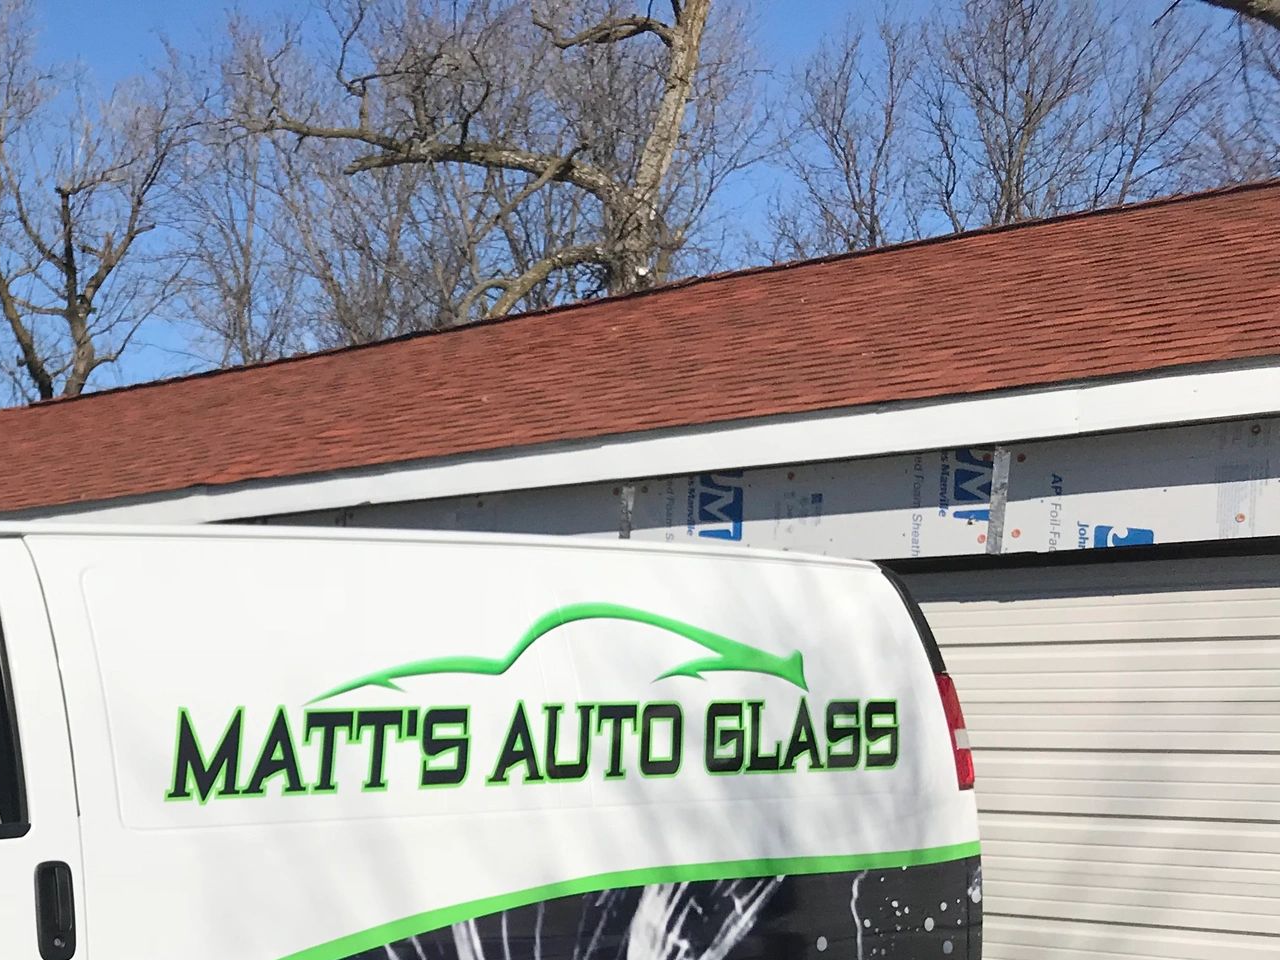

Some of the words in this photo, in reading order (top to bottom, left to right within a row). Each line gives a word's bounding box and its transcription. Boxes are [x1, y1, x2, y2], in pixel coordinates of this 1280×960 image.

[164, 703, 472, 806] MATT'S
[485, 698, 685, 786] AUTO
[704, 696, 900, 776] GLASS
